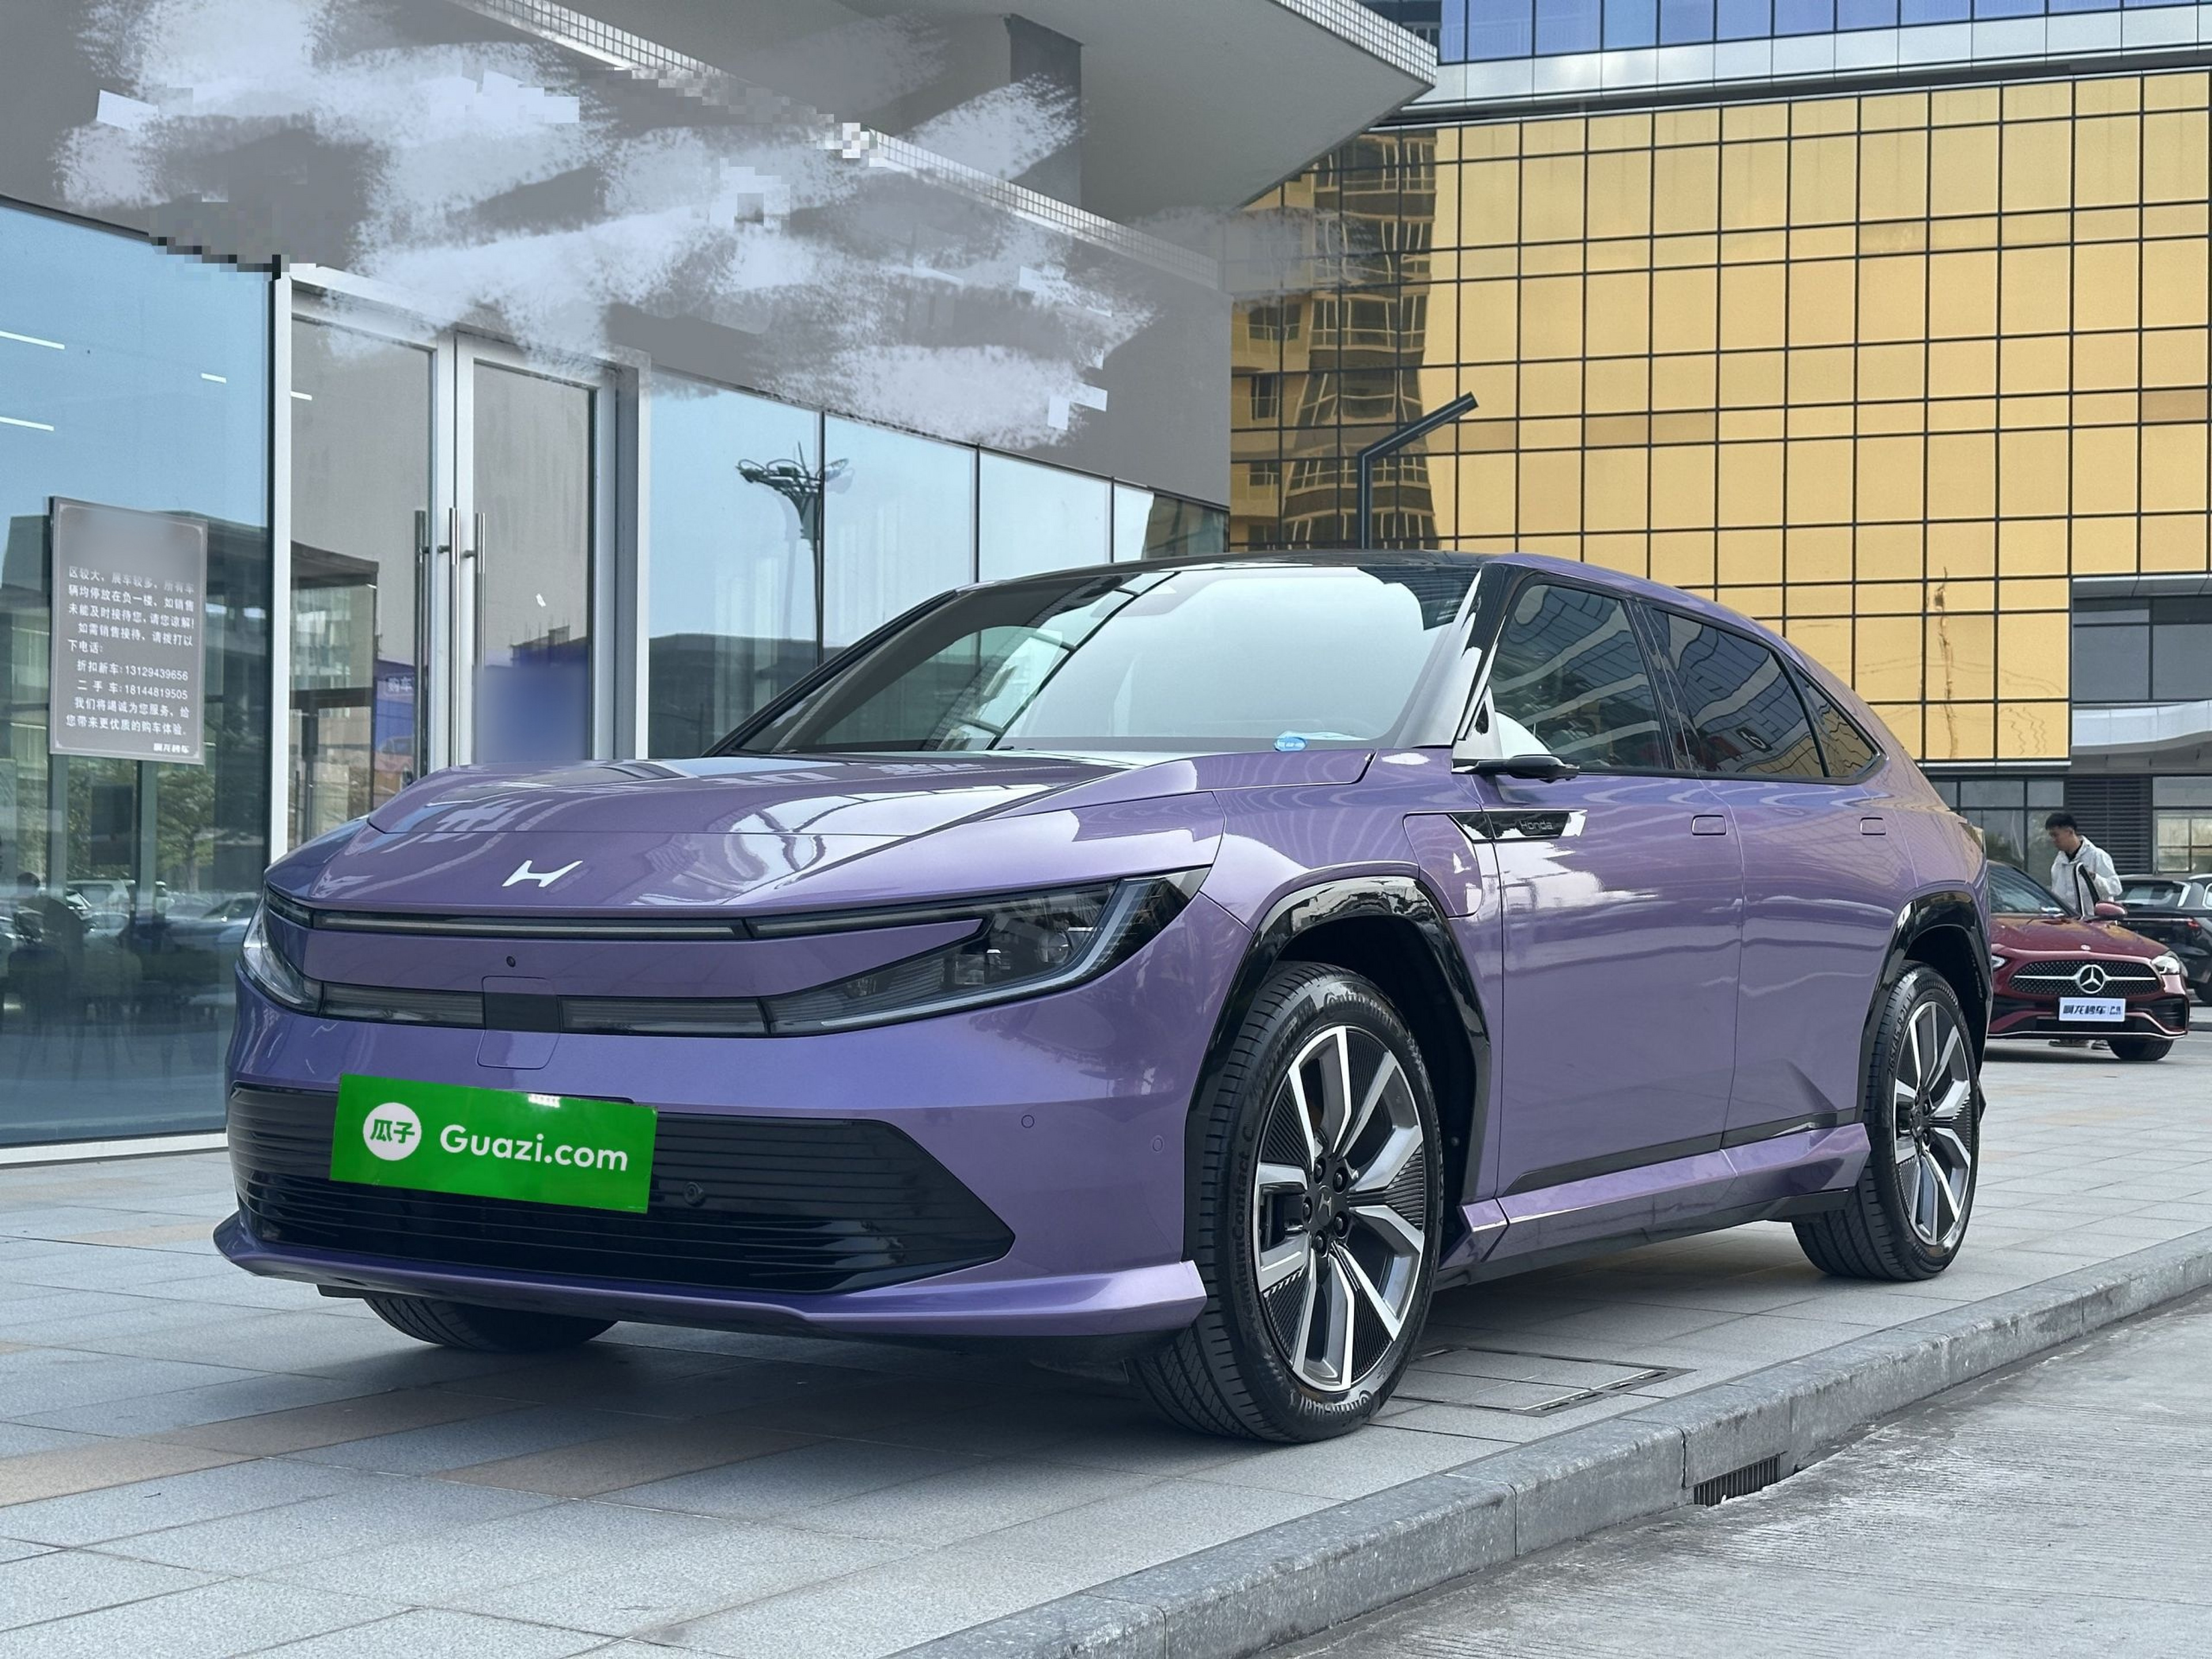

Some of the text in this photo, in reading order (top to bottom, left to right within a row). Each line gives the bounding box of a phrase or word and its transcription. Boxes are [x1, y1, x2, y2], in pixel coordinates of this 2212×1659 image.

[1519, 820, 1554, 831] Honda
[369, 1119, 415, 1144] 瓜子
[440, 1124, 628, 1172] Guazi.com
